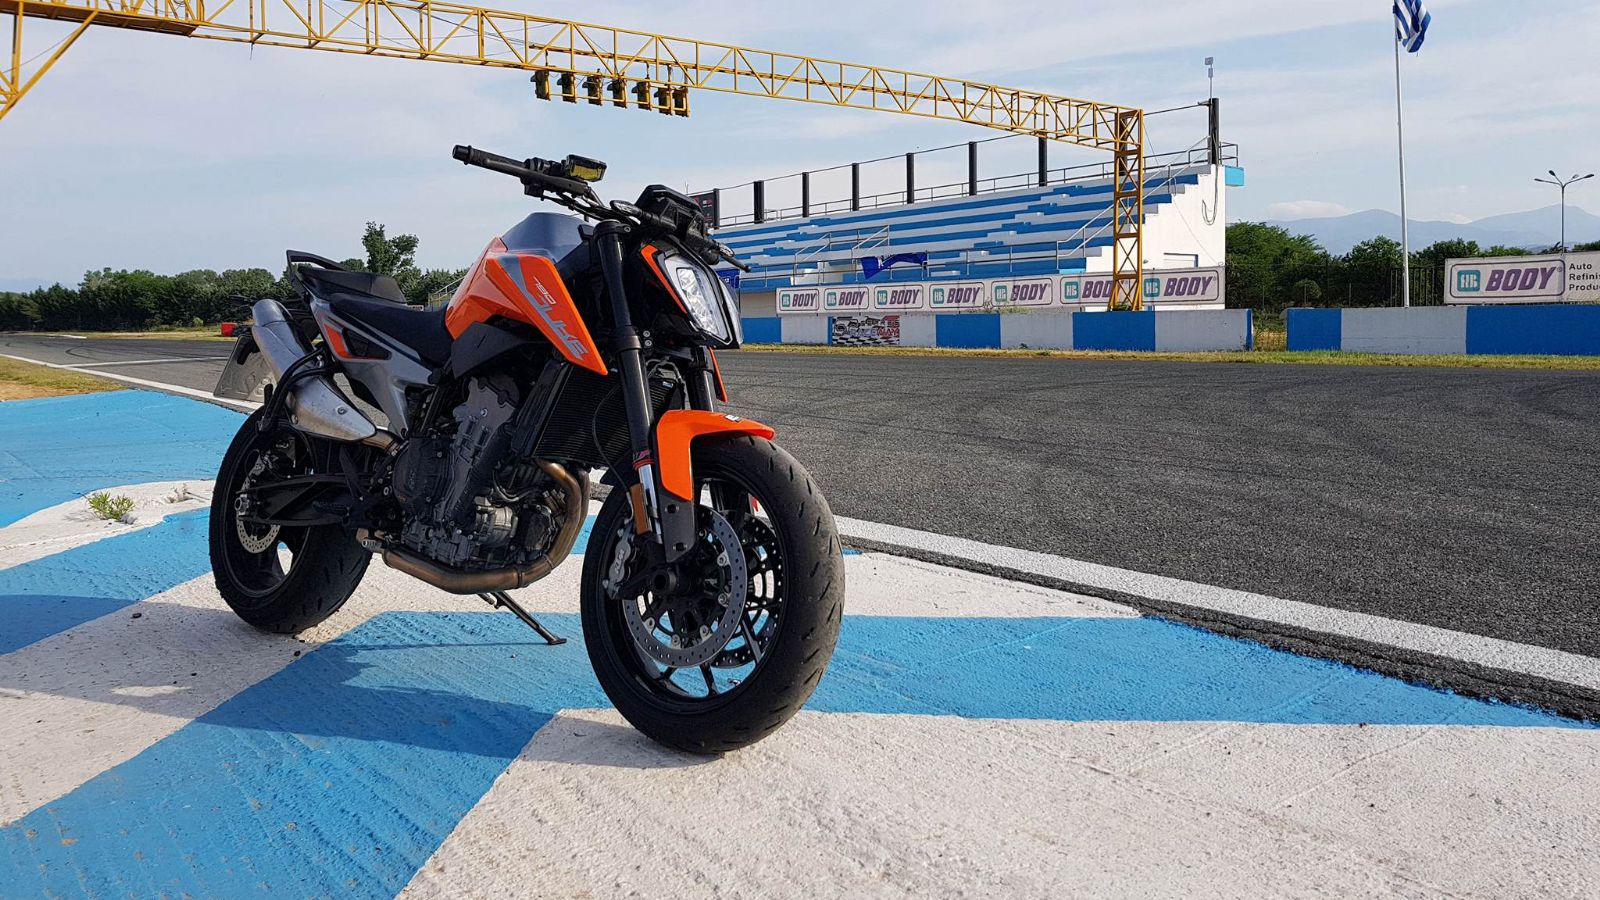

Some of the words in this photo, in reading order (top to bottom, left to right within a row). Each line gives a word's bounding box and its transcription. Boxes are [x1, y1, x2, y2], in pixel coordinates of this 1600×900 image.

[1164, 276, 1213, 296] BODY
[1485, 267, 1556, 291] BODY
[533, 276, 557, 305] 790
[889, 289, 920, 304] BODY
[947, 287, 980, 303] BODY
[1010, 283, 1048, 301] BODY
[1082, 280, 1117, 298] BOD
[792, 293, 817, 307] BODY
[838, 291, 865, 306] BODY
[531, 296, 590, 361] DUKE
